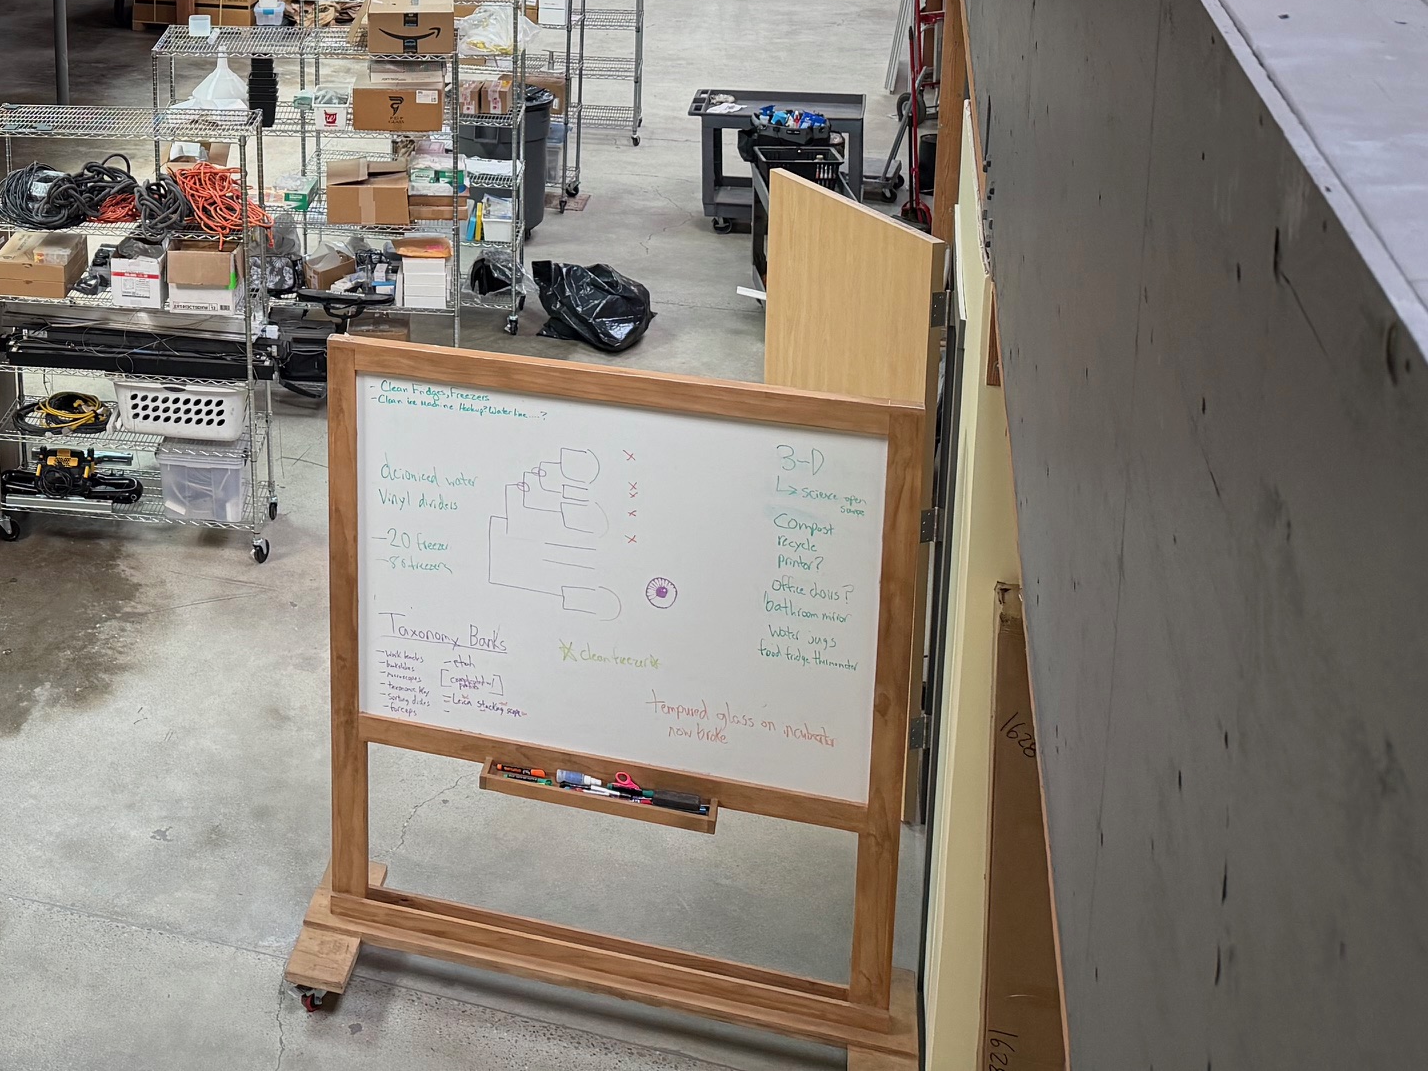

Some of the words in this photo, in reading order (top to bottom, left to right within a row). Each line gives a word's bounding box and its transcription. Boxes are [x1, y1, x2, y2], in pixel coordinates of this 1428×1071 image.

[380, 379, 408, 393] Clean
[377, 611, 460, 651] Taxonomy
[469, 623, 507, 652] Banks
[716, 701, 755, 729] glass
